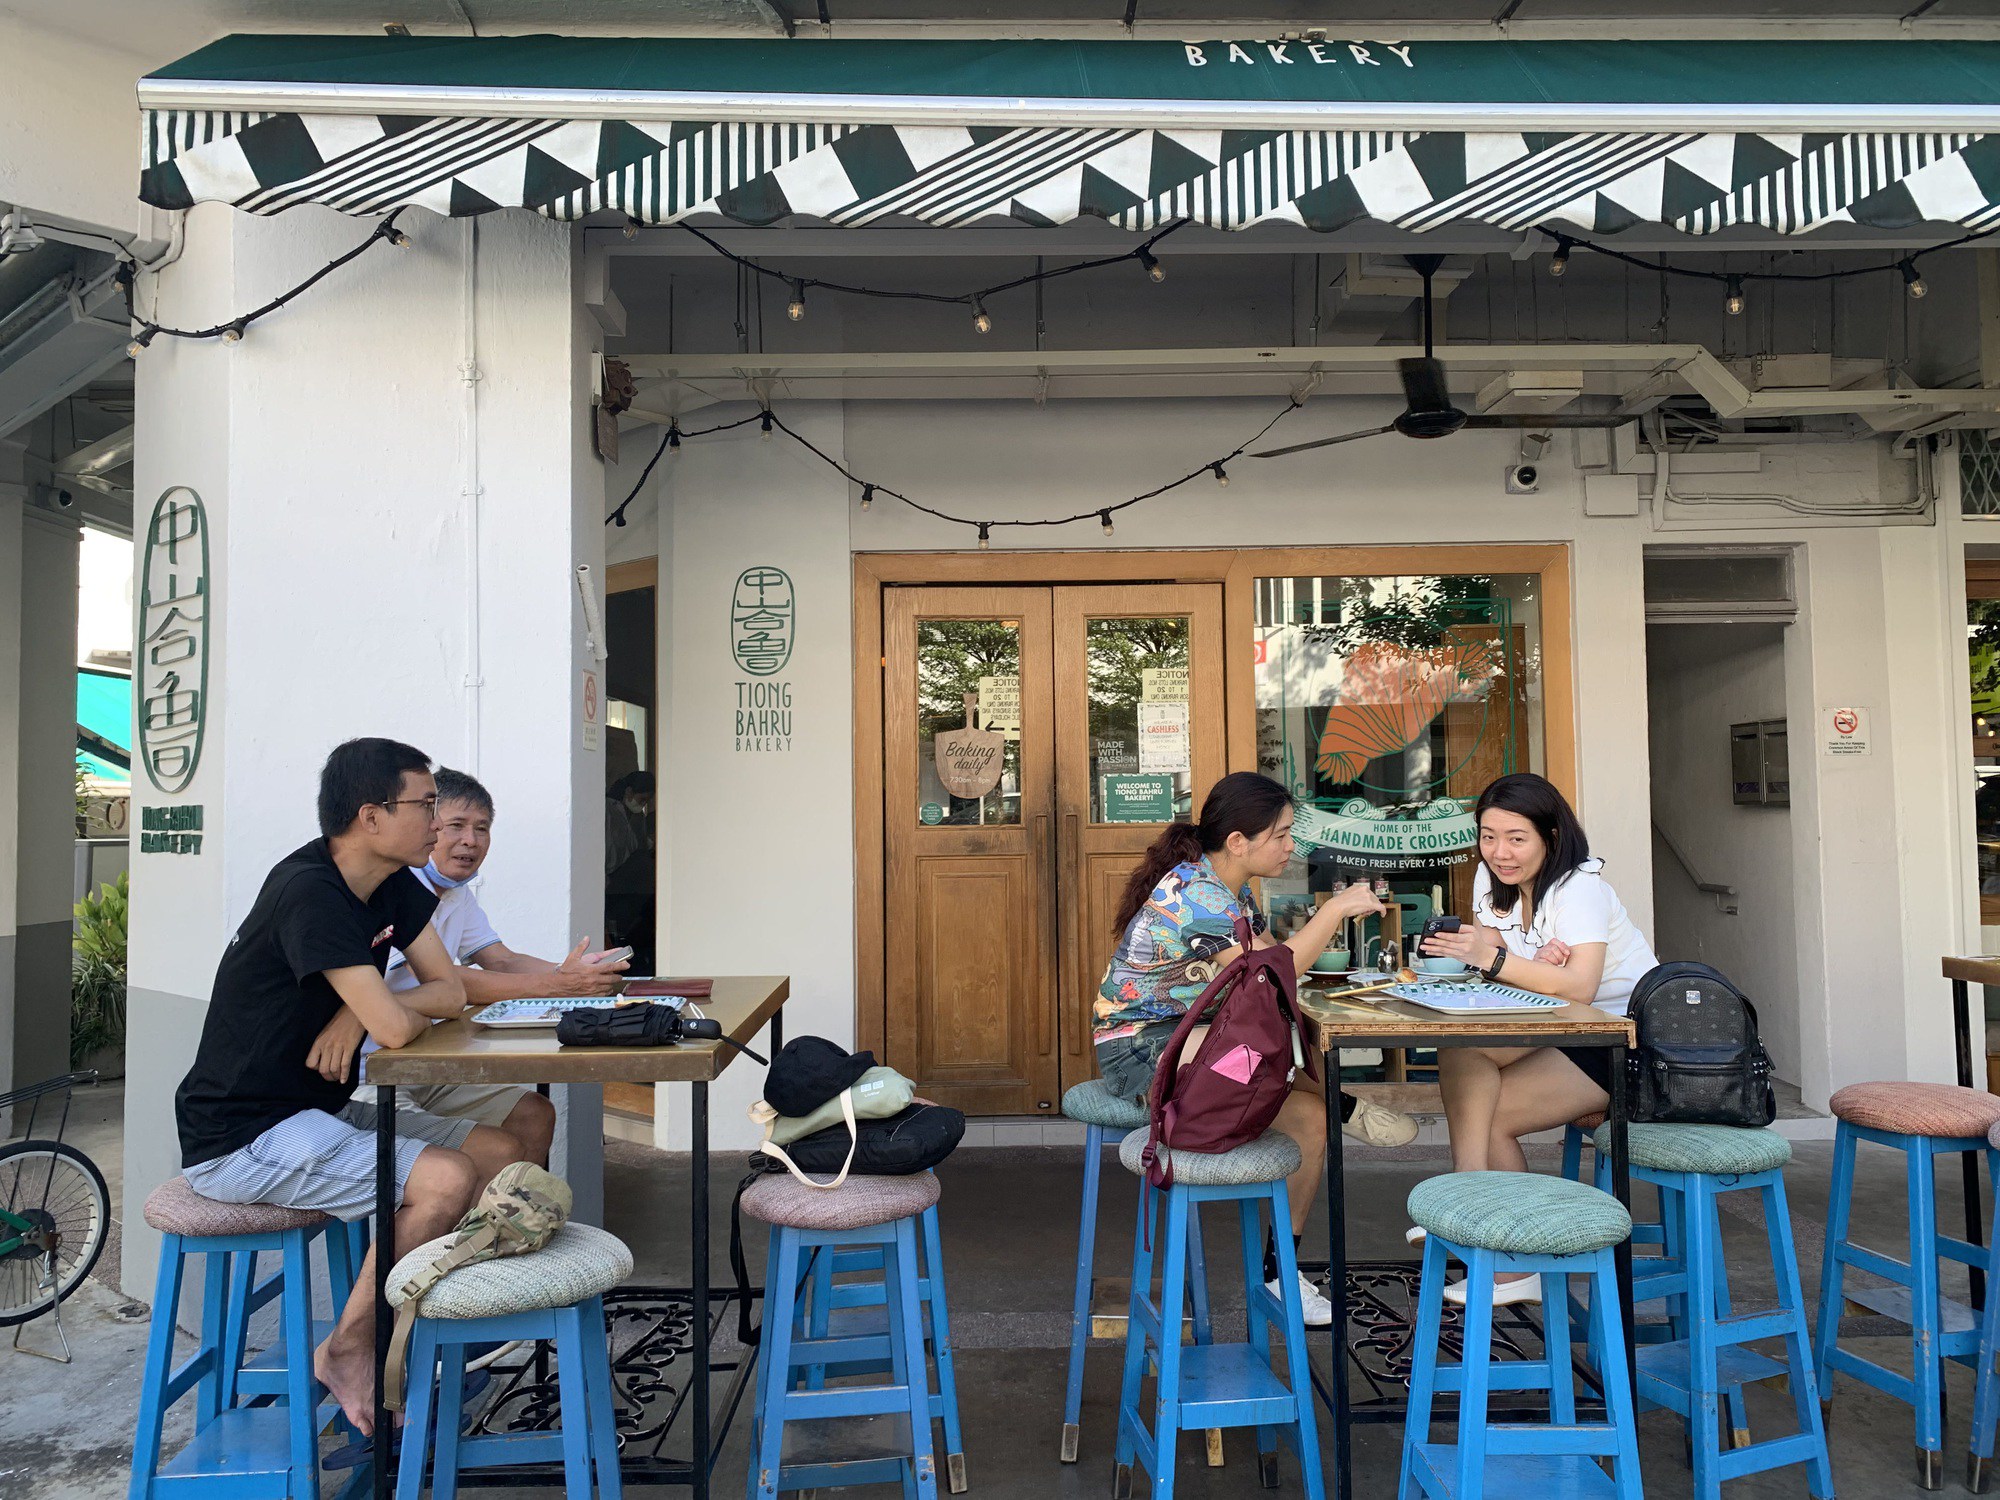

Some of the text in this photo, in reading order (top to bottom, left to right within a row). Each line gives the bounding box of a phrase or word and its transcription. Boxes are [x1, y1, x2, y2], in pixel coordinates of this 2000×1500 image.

[1184, 43, 1414, 67] BAKERY
[734, 682, 792, 708] TIONG
[735, 710, 792, 736] BAHRU
[1147, 725, 1180, 733] CASHLESS
[735, 737, 792, 752] BAKERY
[1097, 740, 1125, 749] MADE
[1098, 748, 1123, 756] WITH
[945, 741, 996, 765] Baking
[1098, 755, 1137, 764] PASSION
[953, 758, 985, 776] daily
[1115, 788, 1138, 796] TIONG
[1373, 823, 1432, 833] HOME OF THE
[1320, 826, 1477, 850] HANDMADE CROISSAN
[1336, 853, 1469, 869] BAKED FRESH EVERY 2 HOURS
